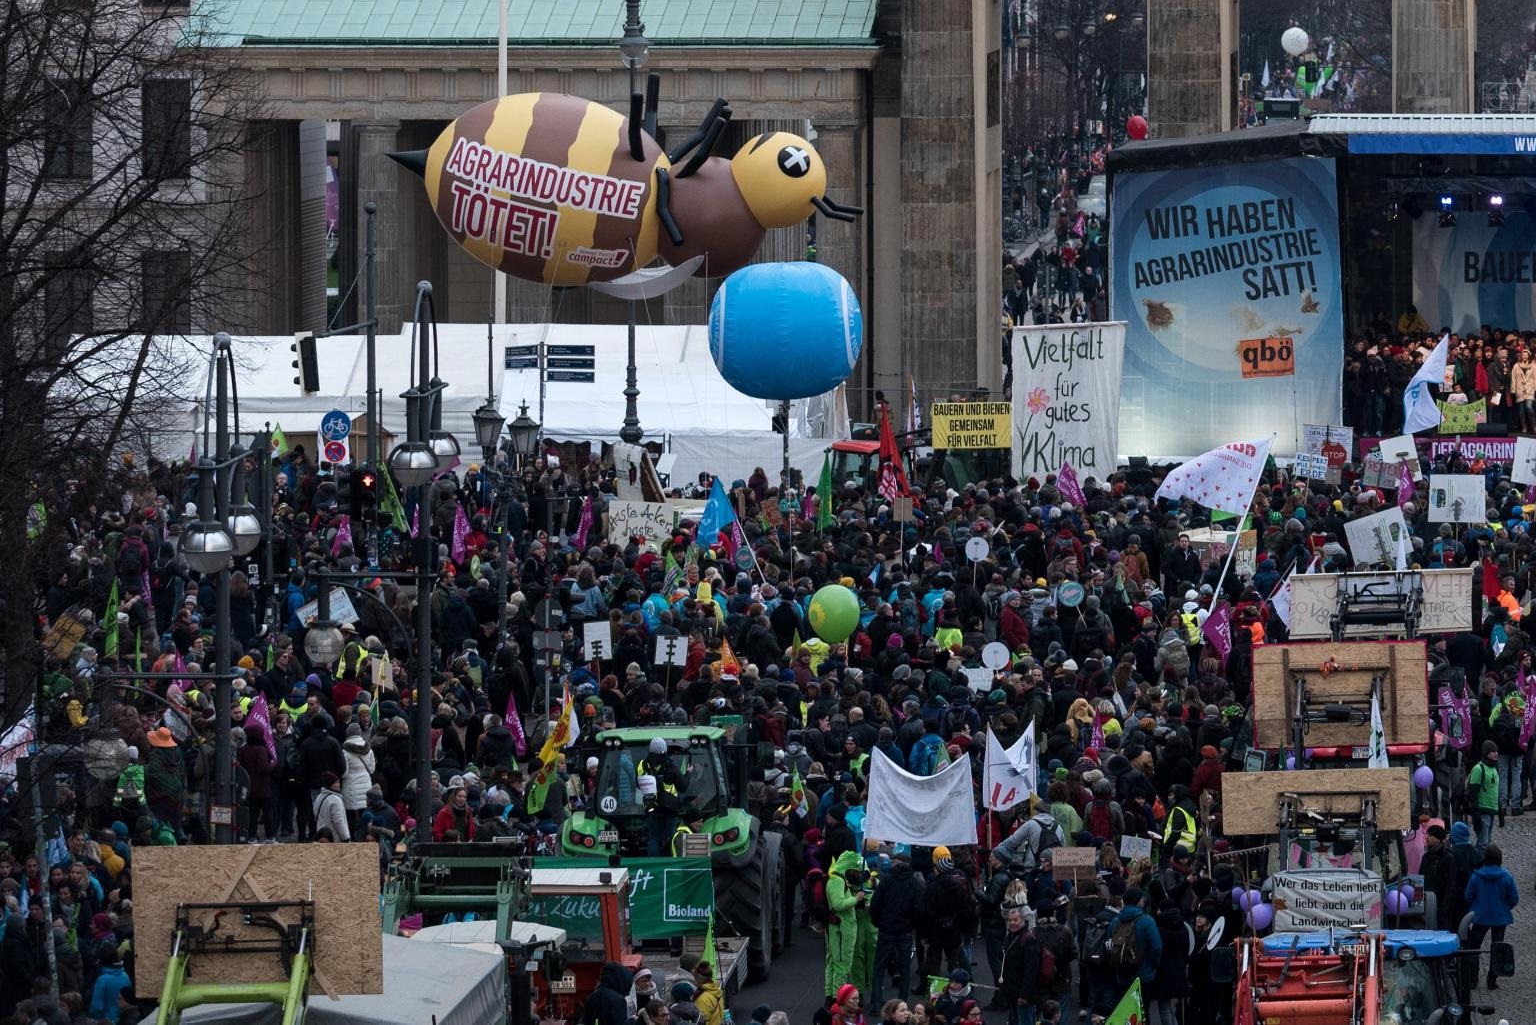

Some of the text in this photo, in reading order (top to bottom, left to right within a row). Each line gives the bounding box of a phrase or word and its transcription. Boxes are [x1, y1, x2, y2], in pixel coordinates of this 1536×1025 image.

[449, 140, 642, 216] AGRARINDUSTRIE
[453, 183, 558, 256] TÖTET!
[1145, 197, 1296, 241] WIR HABEN
[1134, 228, 1322, 289] AGRARINDUSTRIE
[1242, 261, 1317, 301] SATT!
[1022, 328, 1105, 372] Vielfalt
[1243, 339, 1291, 369] qbö
[1054, 372, 1080, 401] für
[933, 402, 1010, 416] BAUERN UND BIENEN
[1045, 401, 1091, 429] gutes
[949, 418, 995, 431] GEMEINSAM
[947, 434, 997, 447] FÜR VIELFALT
[1033, 431, 1096, 474] Klima
[1323, 451, 1345, 460] STOP
[604, 799, 614, 810] 40
[1275, 876, 1381, 894] Wer das Leben liebt,
[668, 904, 711, 917] Bioland
[1295, 898, 1365, 911] liebt auch die
